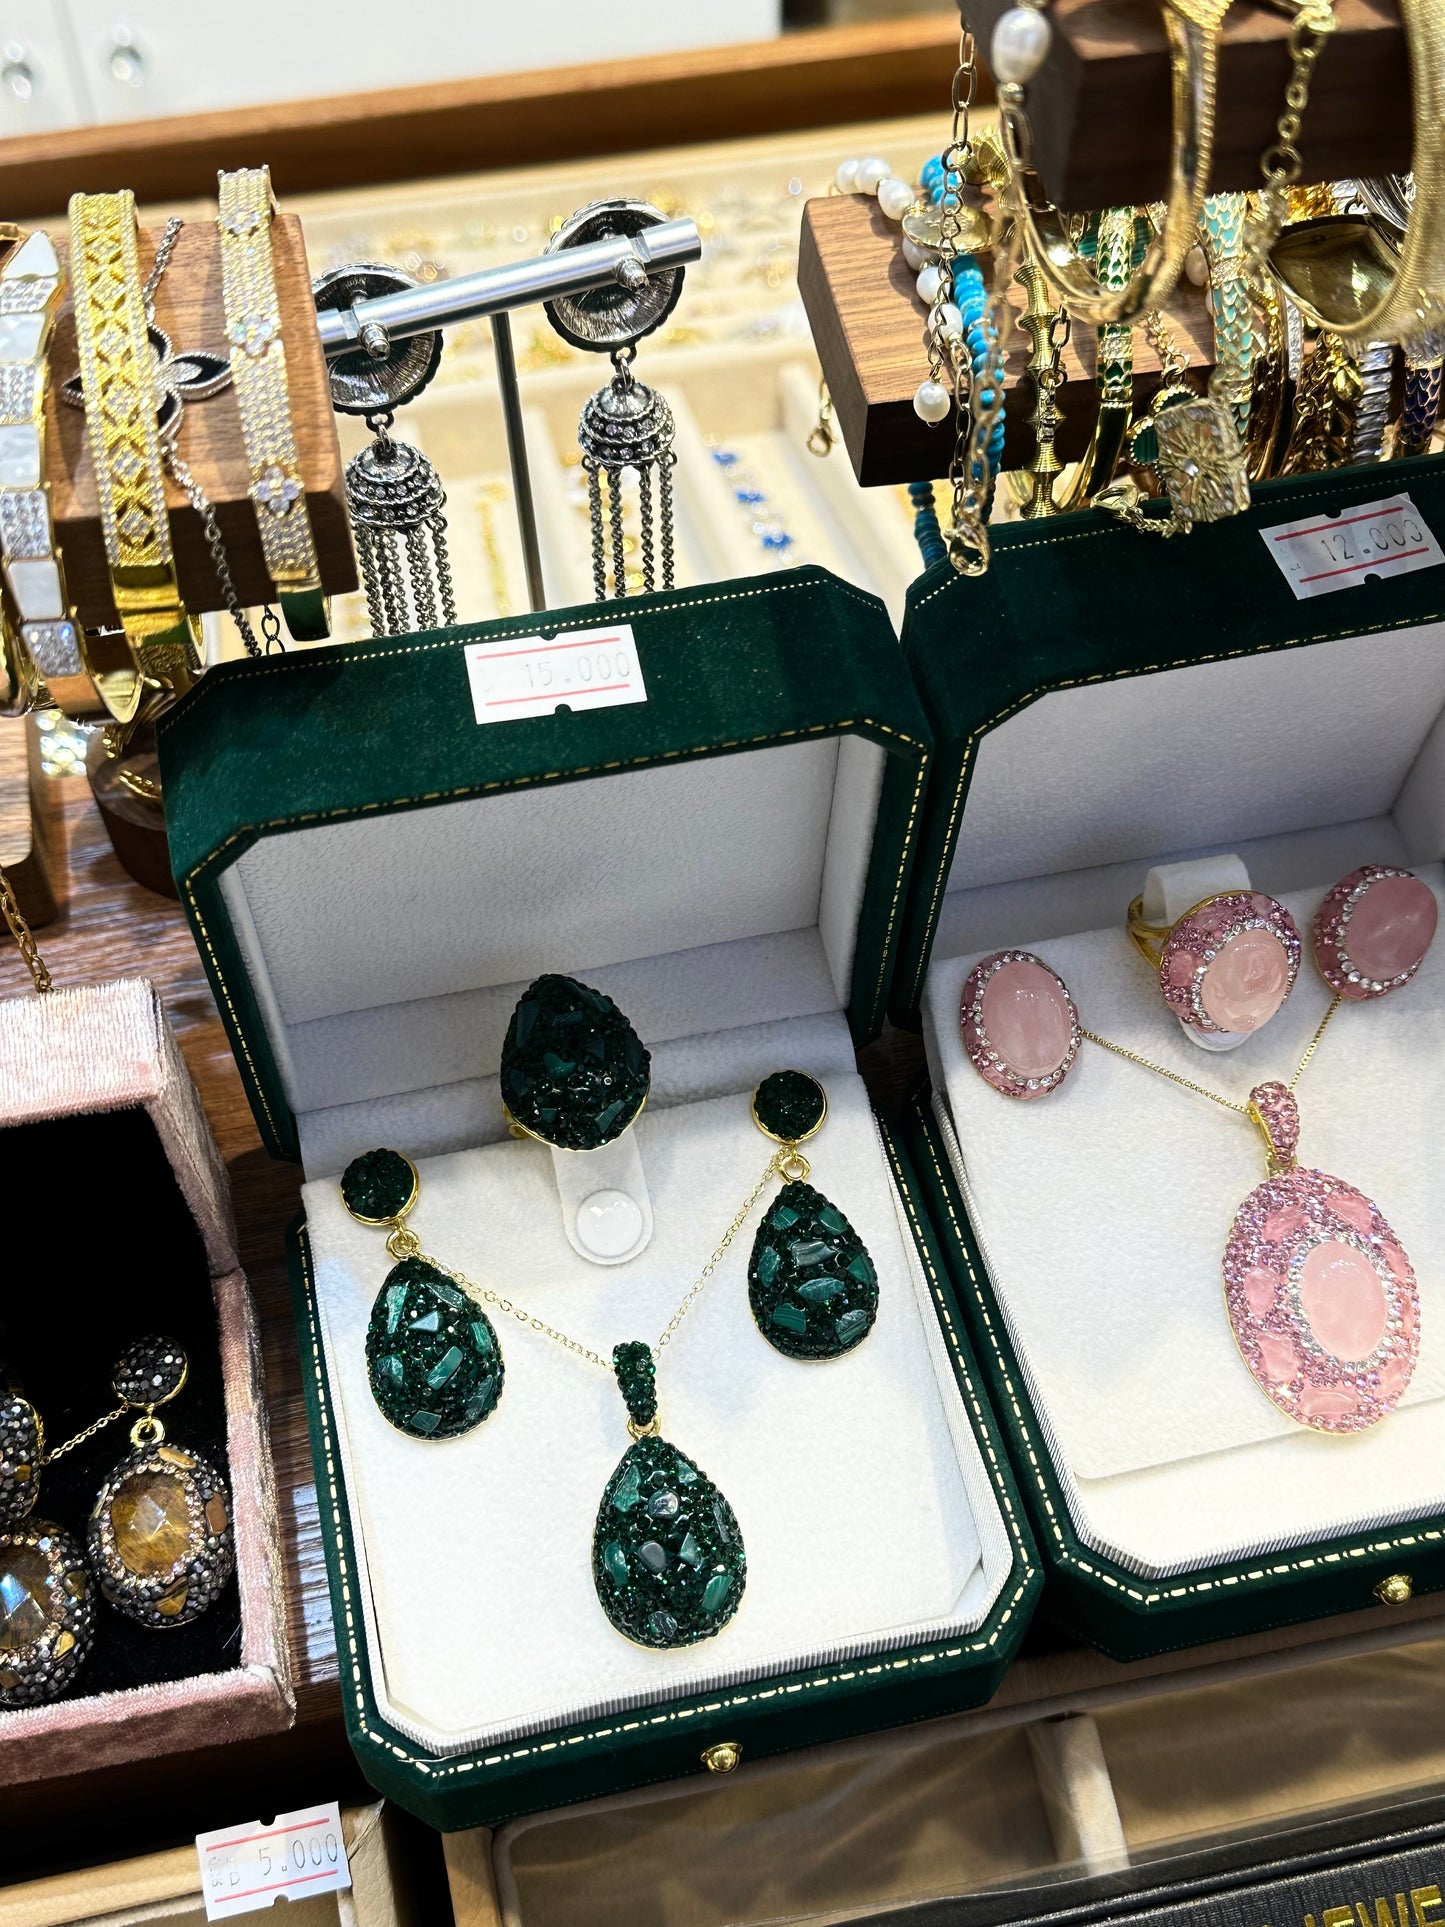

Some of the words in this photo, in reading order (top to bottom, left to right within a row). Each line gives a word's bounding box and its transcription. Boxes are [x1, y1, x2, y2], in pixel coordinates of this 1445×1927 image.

[1321, 519, 1423, 561] 12.000
[524, 651, 631, 688] 15.000
[258, 1833, 338, 1876] 5.000
